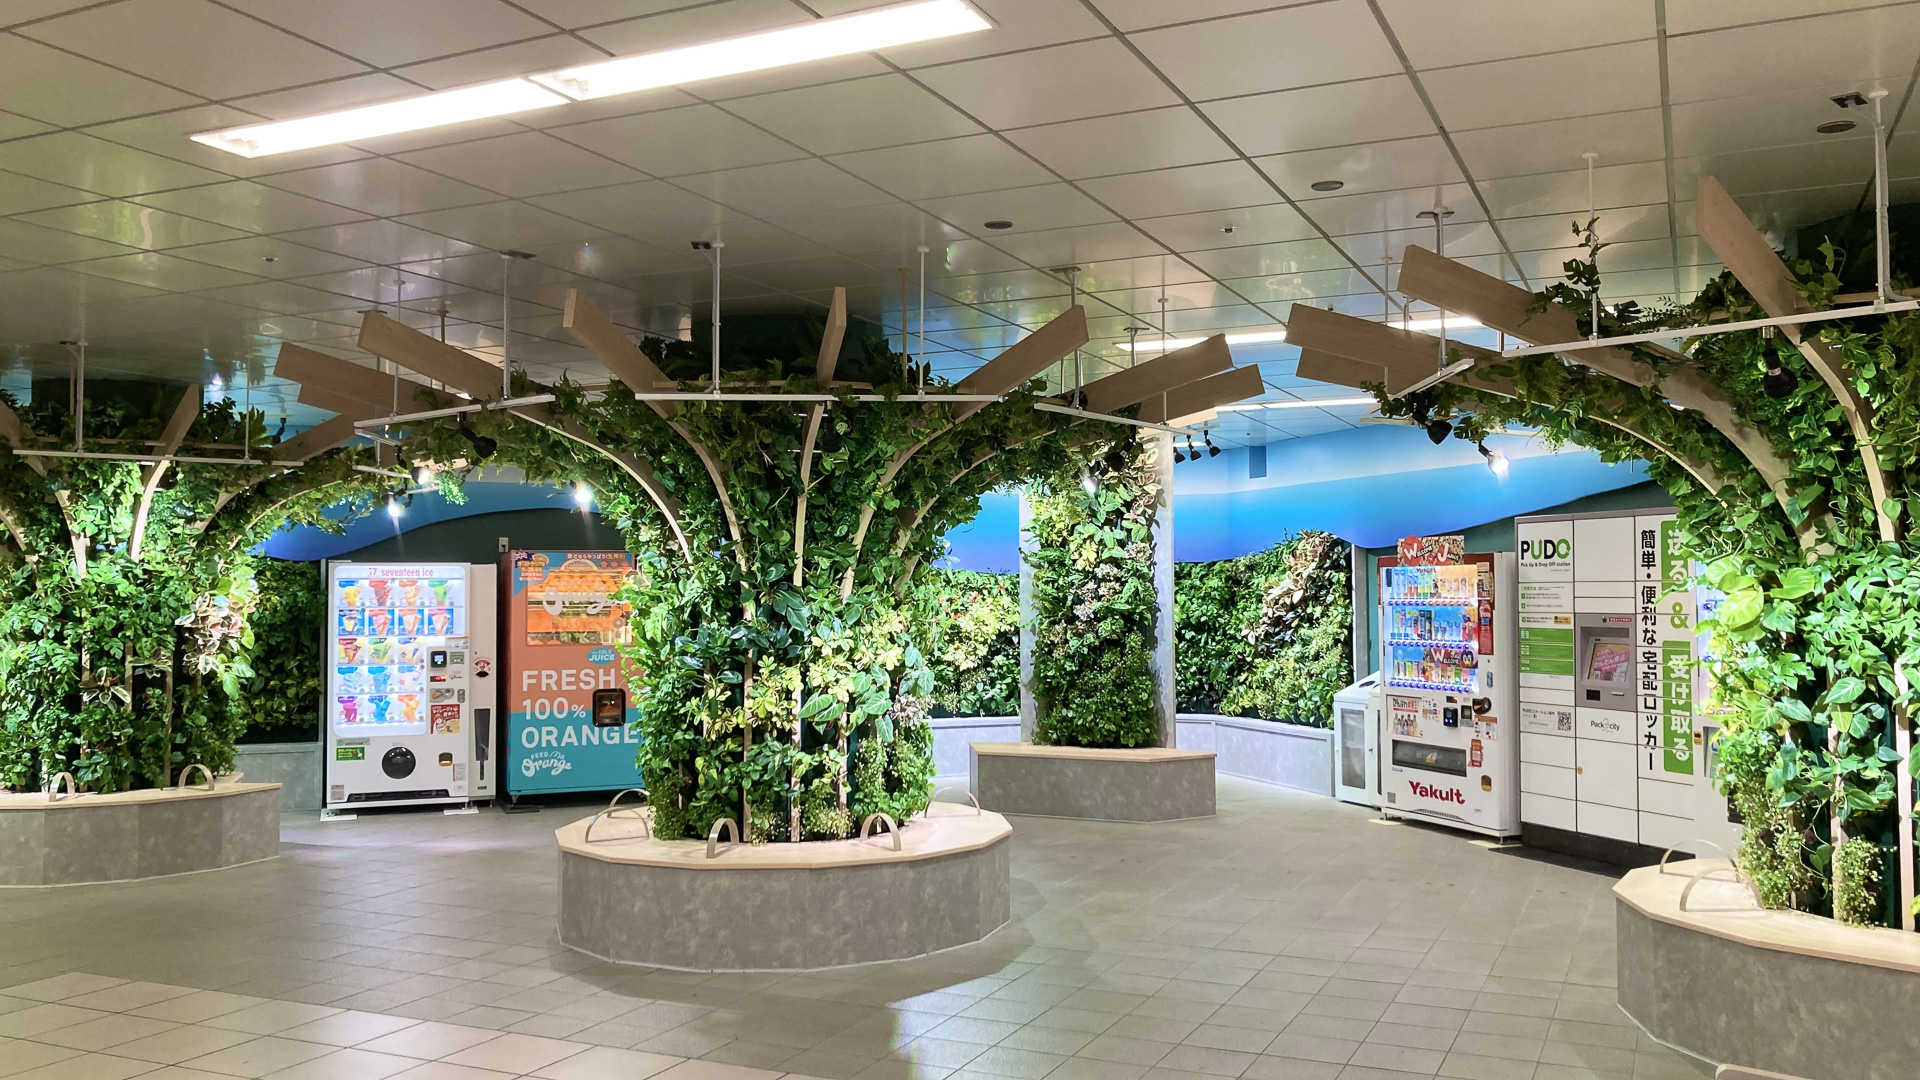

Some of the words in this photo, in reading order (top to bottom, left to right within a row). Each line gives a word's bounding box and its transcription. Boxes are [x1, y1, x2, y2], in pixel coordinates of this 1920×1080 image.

[1520, 538, 1571, 560] PUDO
[381, 568, 420, 576] seventeen
[422, 568, 434, 576] ice
[1670, 602, 1689, 629] &
[522, 668, 616, 692] FRESH
[522, 697, 586, 720] 100%
[1669, 655, 1691, 761] 受け取る
[521, 723, 639, 749] ORANGE
[530, 751, 549, 760] FEED
[521, 758, 572, 777] Orange
[1408, 780, 1466, 805] Yakult
